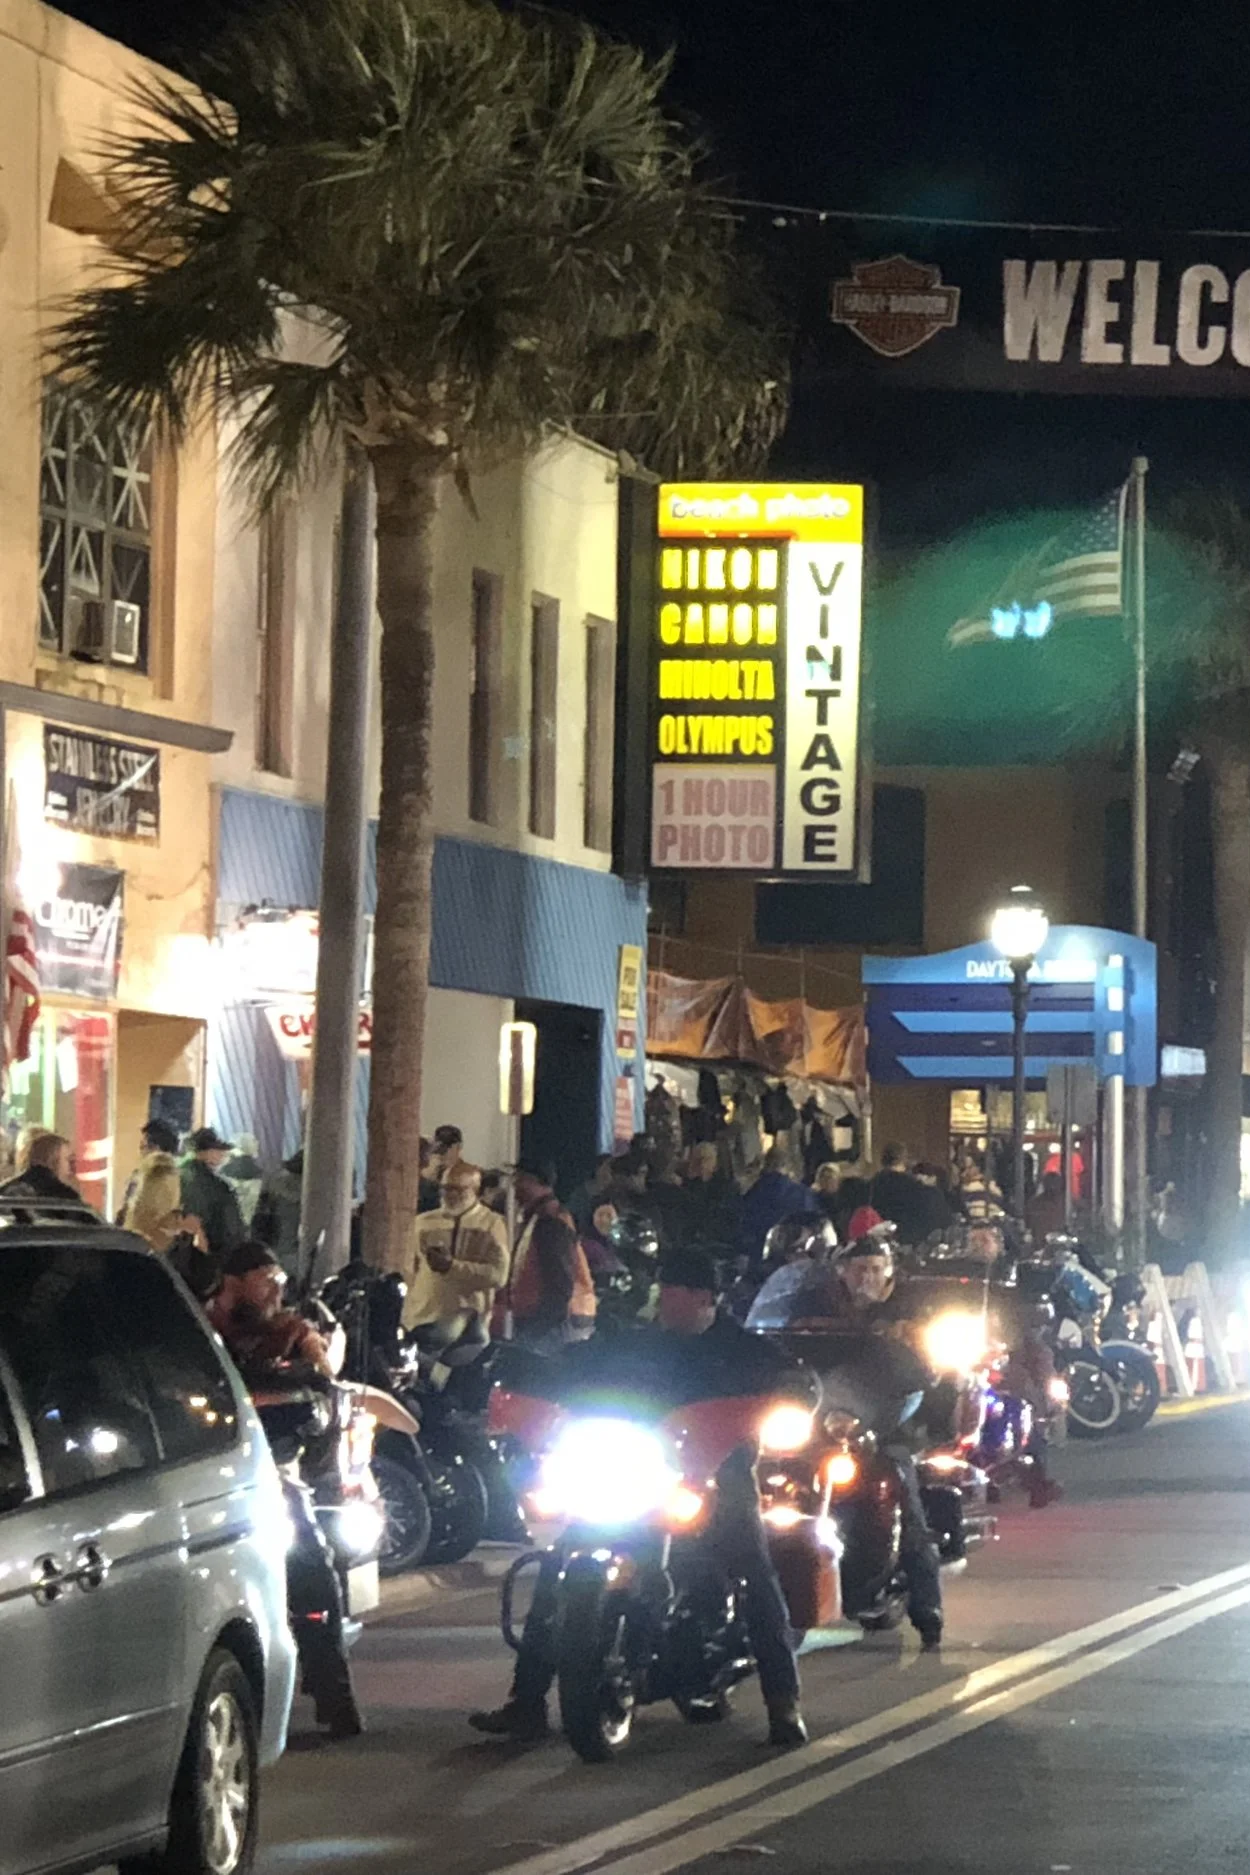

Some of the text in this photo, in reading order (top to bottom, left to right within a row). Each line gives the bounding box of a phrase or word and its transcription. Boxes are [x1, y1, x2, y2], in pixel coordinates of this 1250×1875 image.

[662, 548, 778, 591] NIKON
[661, 603, 777, 645] CANON
[659, 660, 775, 700] MINOLTA
[800, 561, 844, 863] VINTAGE
[659, 715, 774, 756] OLYMPUS
[659, 779, 770, 817] 1 HOUR
[658, 824, 770, 863] PHOTO
[966, 959, 1042, 979] DAYTA
